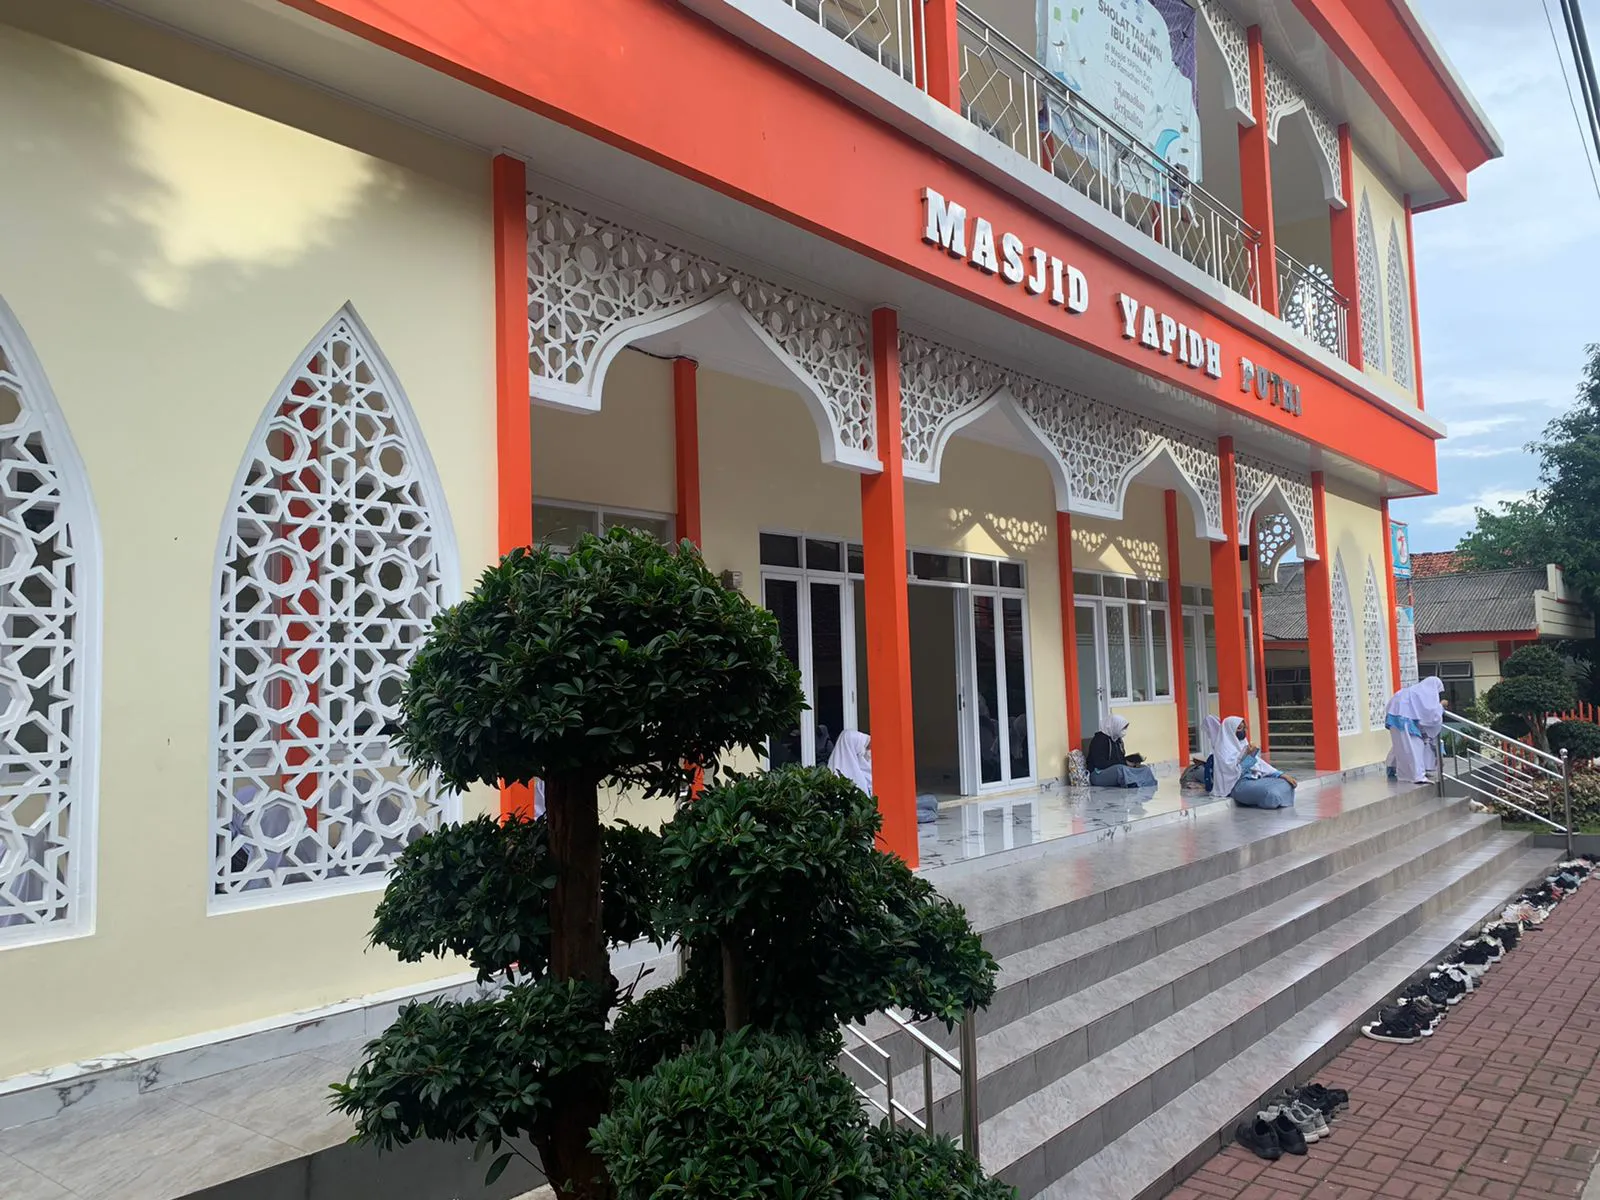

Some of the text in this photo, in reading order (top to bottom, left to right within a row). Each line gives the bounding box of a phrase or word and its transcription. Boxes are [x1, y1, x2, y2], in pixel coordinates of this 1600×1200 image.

[1111, 24, 1124, 44] IBU
[1132, 43, 1152, 69] ANAK
[921, 187, 1302, 416] MASJID YAPIDH PUTRI
